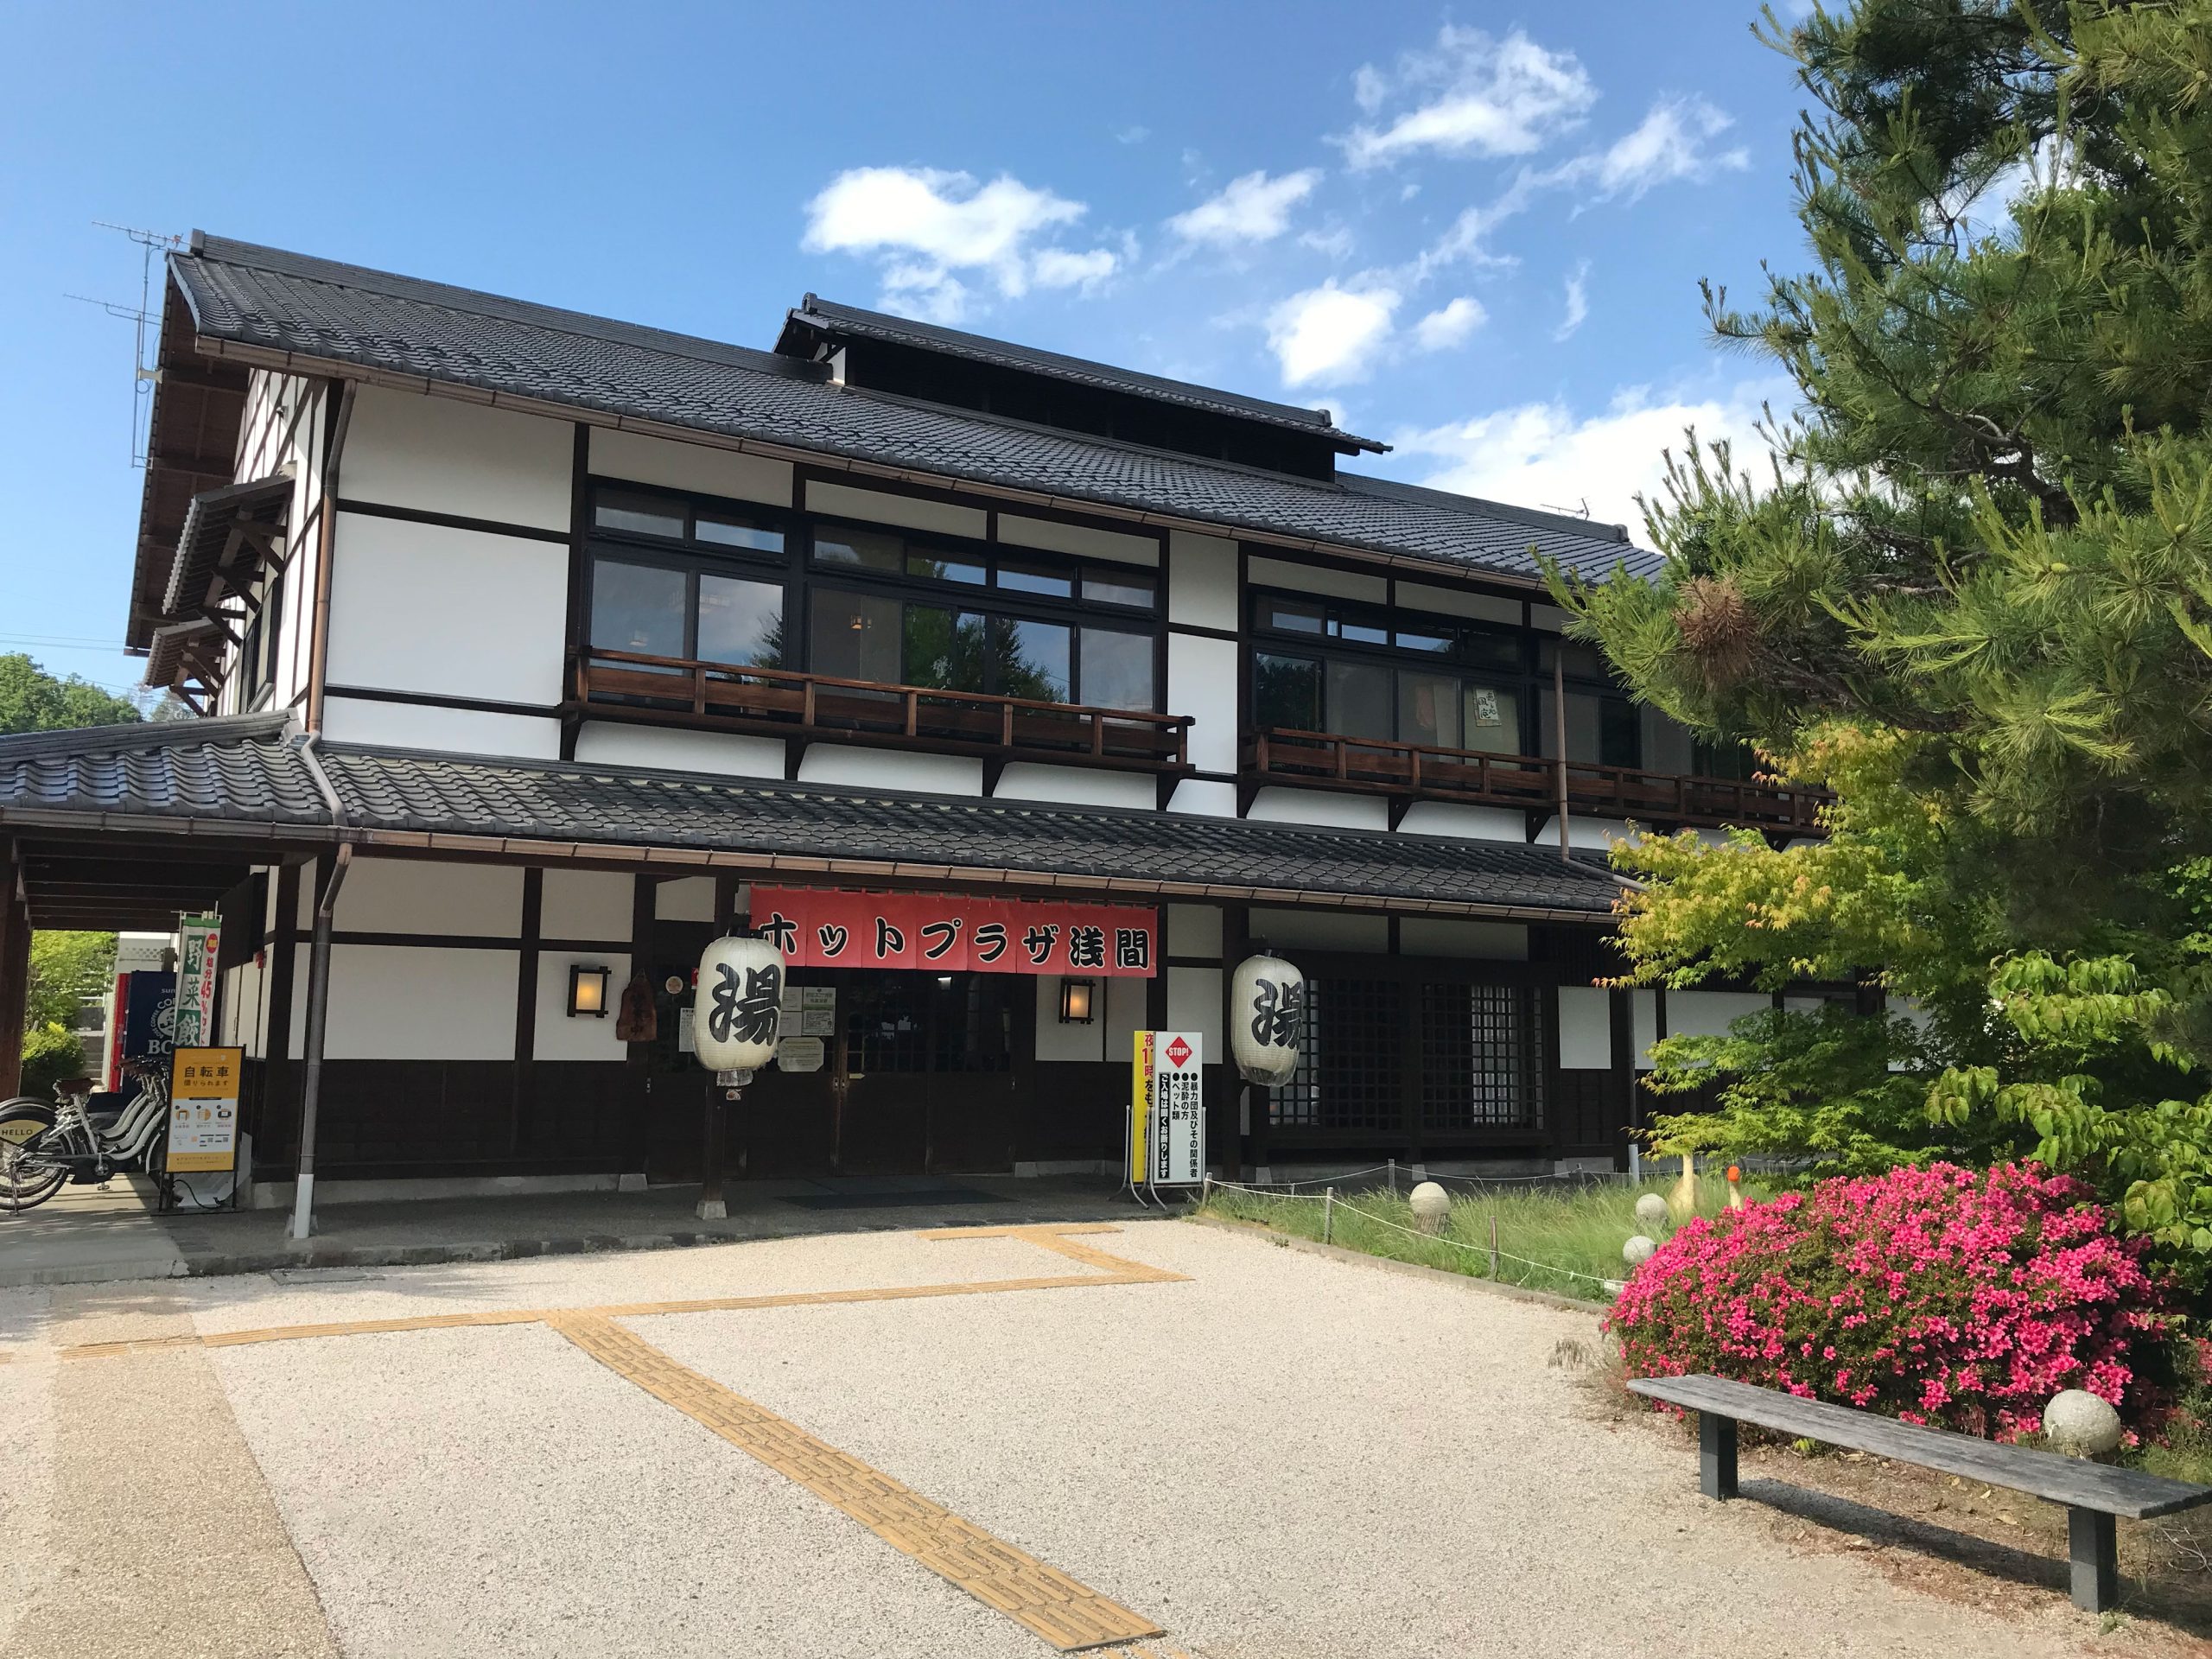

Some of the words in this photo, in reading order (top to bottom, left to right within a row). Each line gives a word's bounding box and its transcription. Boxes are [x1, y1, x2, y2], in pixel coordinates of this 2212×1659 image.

[760, 912, 1150, 969] ホットプラザ浅間
[709, 963, 781, 1046] 湯
[1251, 978, 1302, 1051] 湯
[184, 1065, 229, 1077] 自転車
[1168, 1046, 1189, 1057] STOP!
[1172, 1083, 1180, 1121] ペット類
[1190, 1082, 1198, 1178] 暴力団及びその関係者
